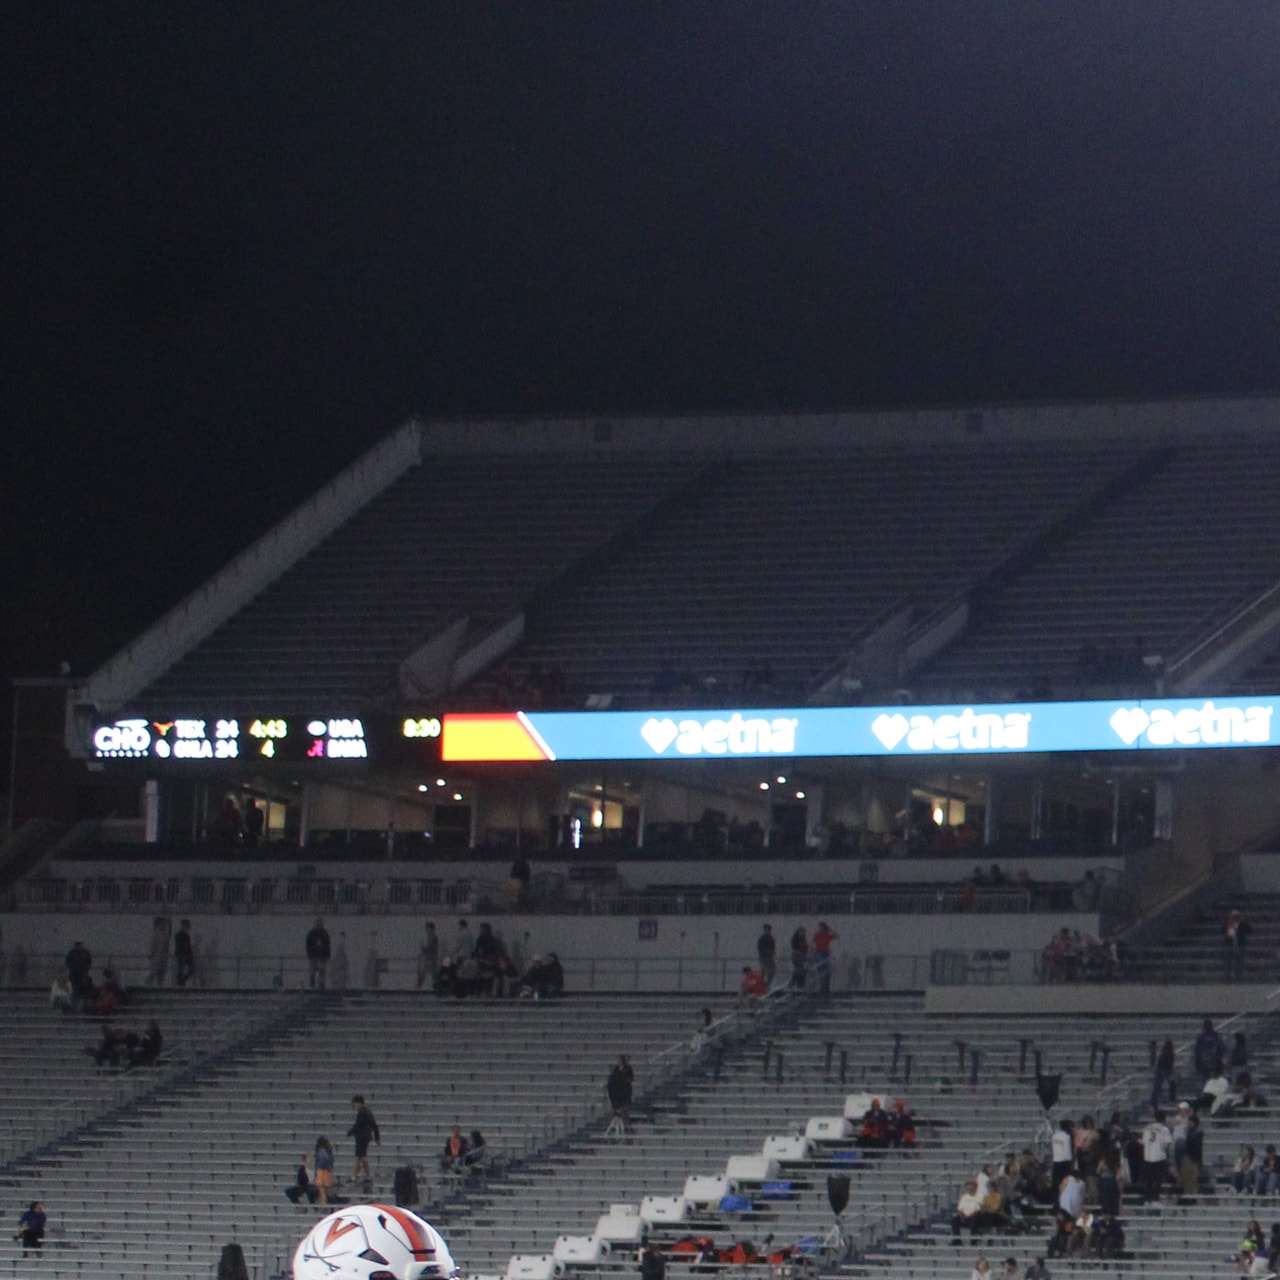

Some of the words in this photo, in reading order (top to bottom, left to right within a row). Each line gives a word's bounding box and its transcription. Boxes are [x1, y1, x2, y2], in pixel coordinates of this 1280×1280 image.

[173, 719, 206, 739] TEX
[215, 719, 239, 739] 24
[249, 719, 288, 739] 4:43
[676, 714, 797, 753] aetna
[908, 708, 1030, 749] aetna
[1147, 702, 1272, 744] aetna
[94, 728, 151, 752] CHO
[214, 739, 239, 758] 24
[261, 739, 275, 758] 4
